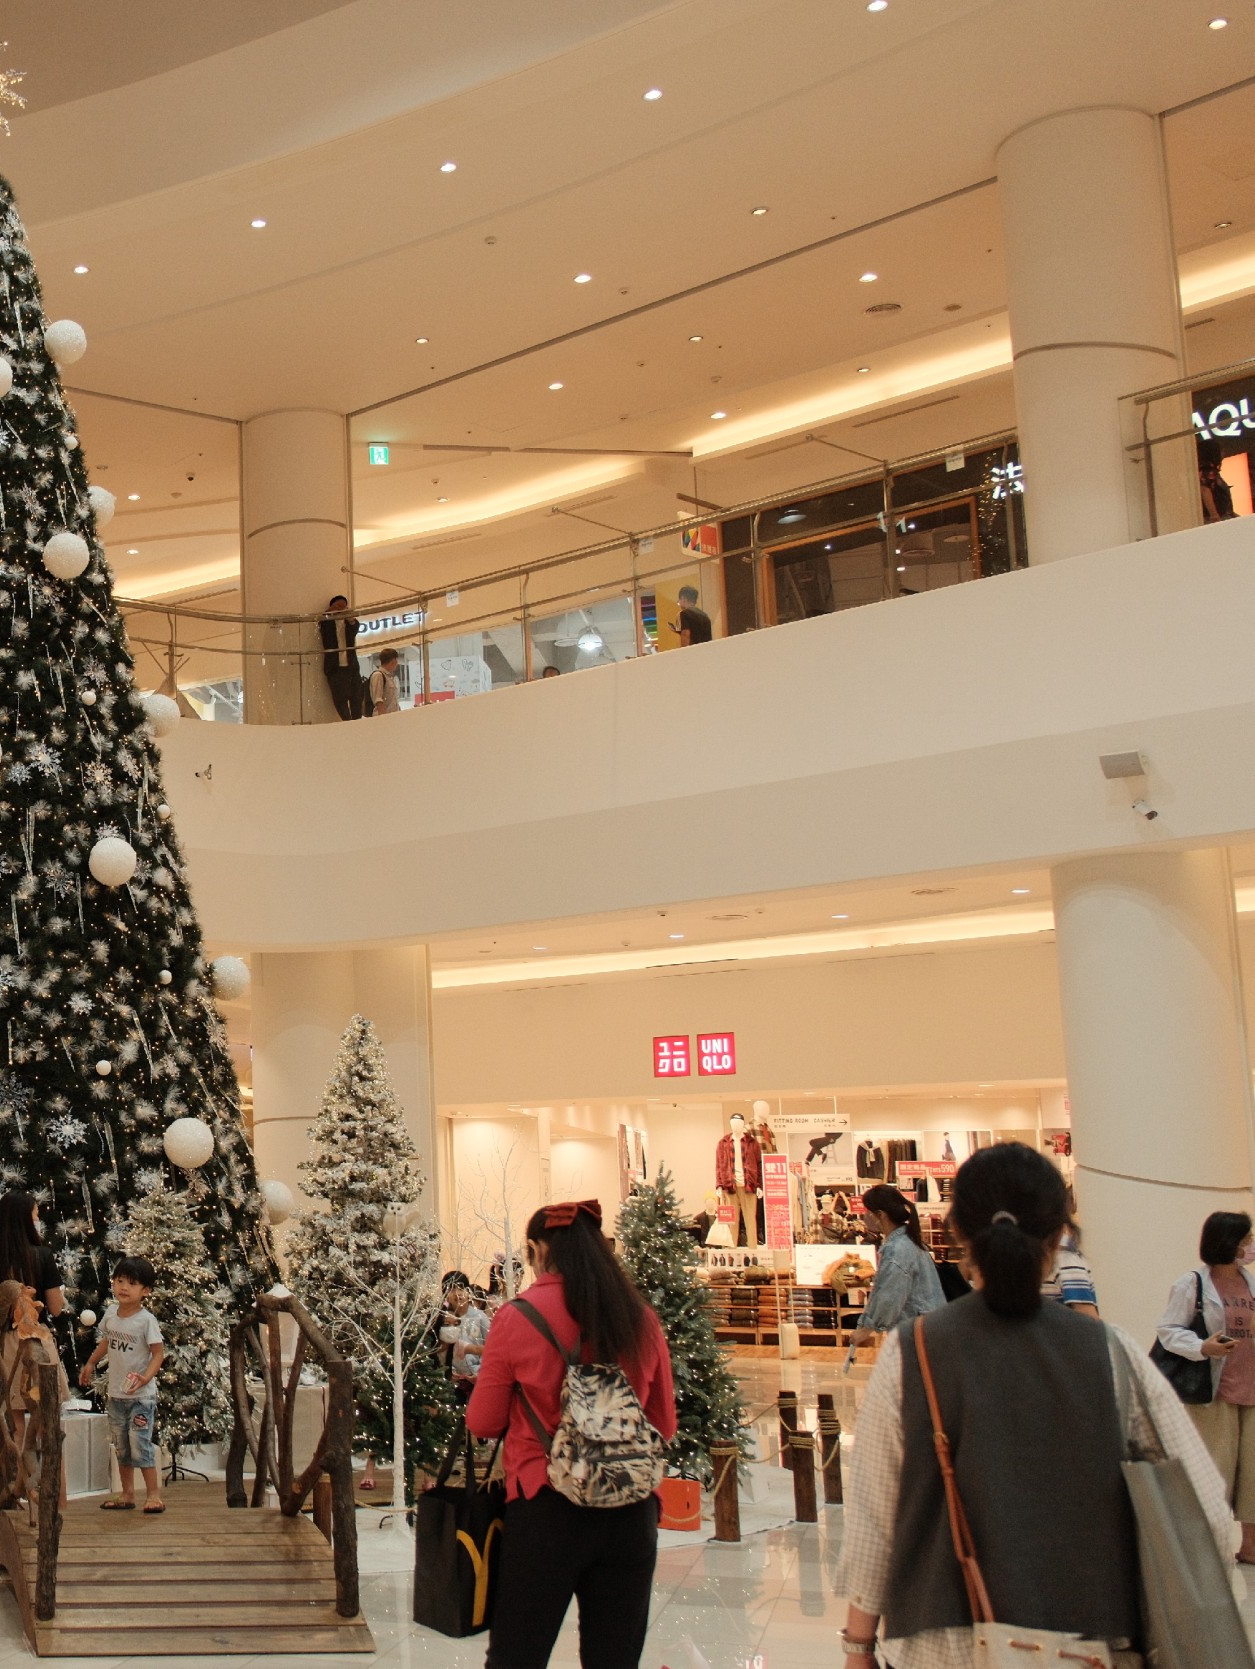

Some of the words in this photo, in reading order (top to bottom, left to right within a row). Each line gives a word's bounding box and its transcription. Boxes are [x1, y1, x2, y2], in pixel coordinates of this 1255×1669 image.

[357, 611, 423, 634] OUTLET
[658, 1041, 685, 1056] ユニ
[701, 1038, 729, 1054] UNI
[658, 1058, 686, 1073] クロ
[702, 1054, 731, 1072] QLO
